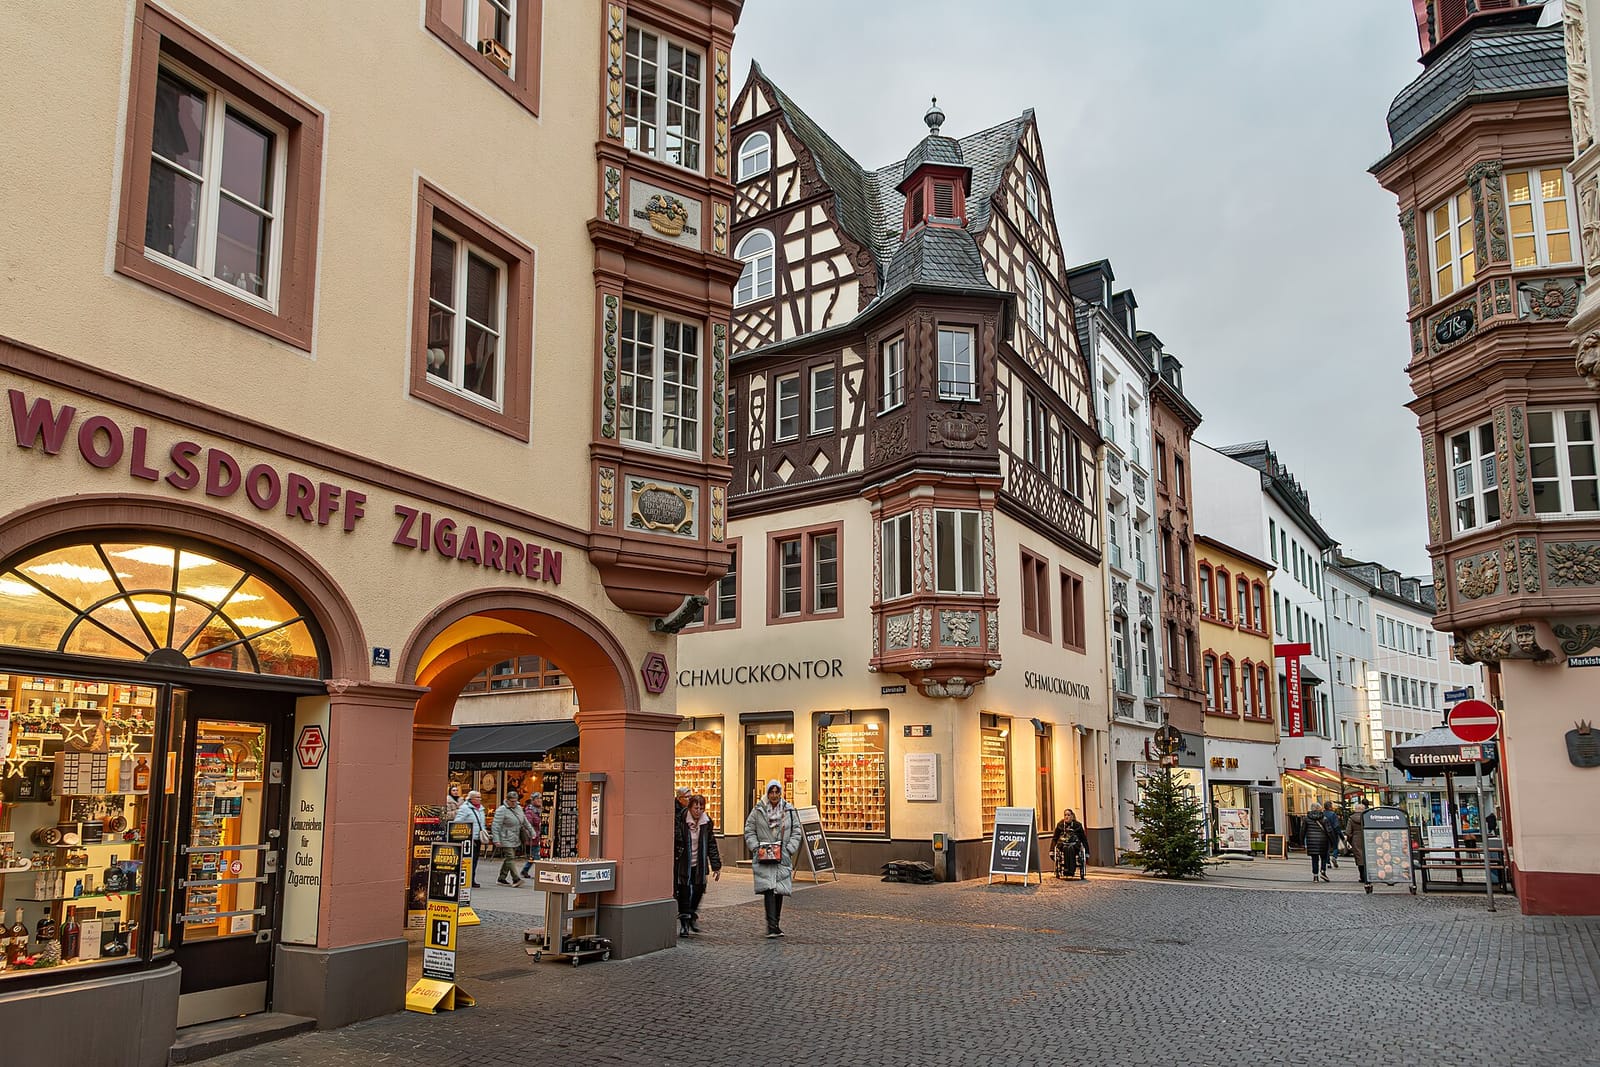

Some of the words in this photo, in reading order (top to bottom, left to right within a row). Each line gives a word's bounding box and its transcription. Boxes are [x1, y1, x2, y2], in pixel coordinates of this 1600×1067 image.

[1486, 459, 1495, 486] NEEB
[8, 389, 367, 533] WOLSDORFF
[392, 504, 563, 585] ZIGARREN
[1458, 469, 1467, 495] NEEB
[379, 649, 385, 658] 2
[1024, 670, 1090, 700] SCHMUCKKONTOR
[1293, 712, 1301, 734] You
[1409, 753, 1476, 764] frittenw
[300, 799, 314, 813] Das
[291, 816, 322, 831] Kennzeichen
[300, 835, 309, 848] für
[295, 851, 313, 867] Gute
[1000, 849, 1022, 857] WEEK
[288, 869, 320, 888] Zigarren
[444, 874, 457, 897] 10
[434, 904, 449, 913] LOTTO
[437, 921, 449, 946] 13
[421, 988, 442, 998] LOTTO
